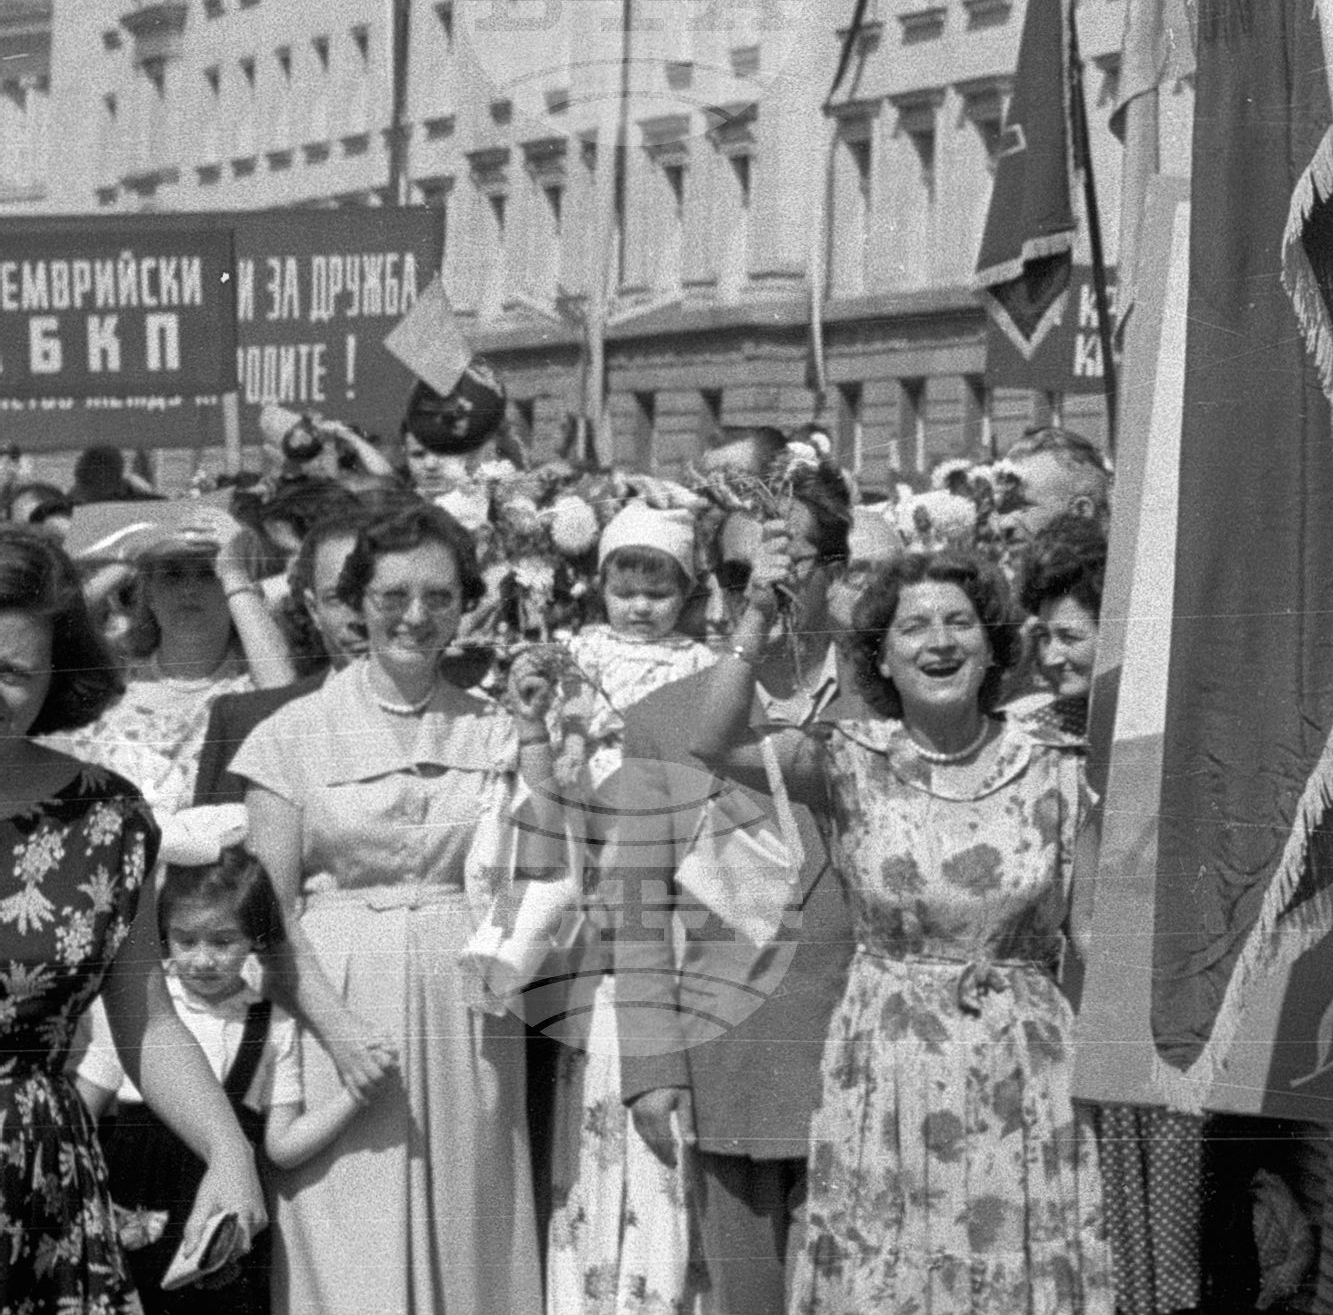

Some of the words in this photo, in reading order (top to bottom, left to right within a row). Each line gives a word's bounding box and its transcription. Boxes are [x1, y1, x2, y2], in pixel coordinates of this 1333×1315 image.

[0, 250, 201, 311] ЕМВРИЙСКИ
[266, 256, 300, 320] ЗА
[310, 252, 419, 323] ДРУЖБА
